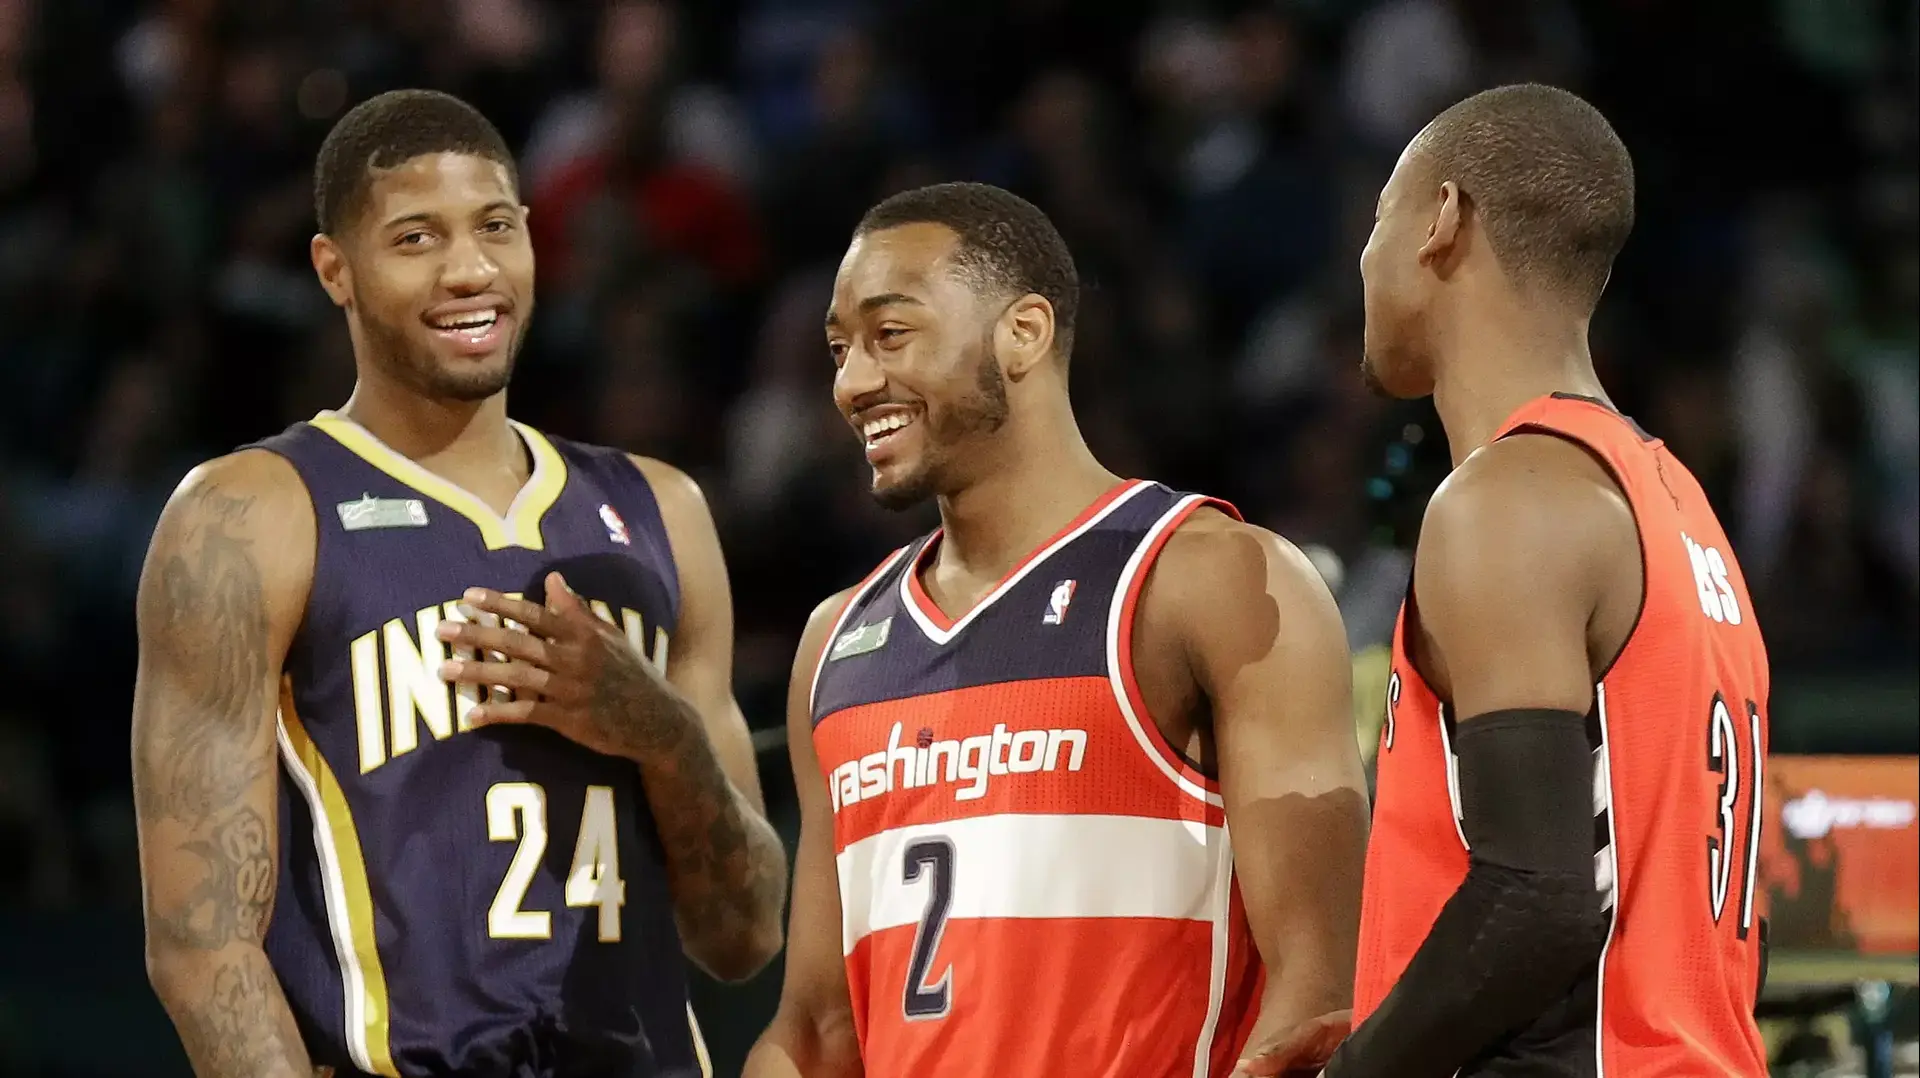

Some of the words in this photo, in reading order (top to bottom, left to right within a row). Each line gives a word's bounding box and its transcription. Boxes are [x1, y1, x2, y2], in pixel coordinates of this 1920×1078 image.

[485, 781, 626, 943] 24
[1706, 691, 1764, 940] 31
[902, 834, 956, 1021] 2
